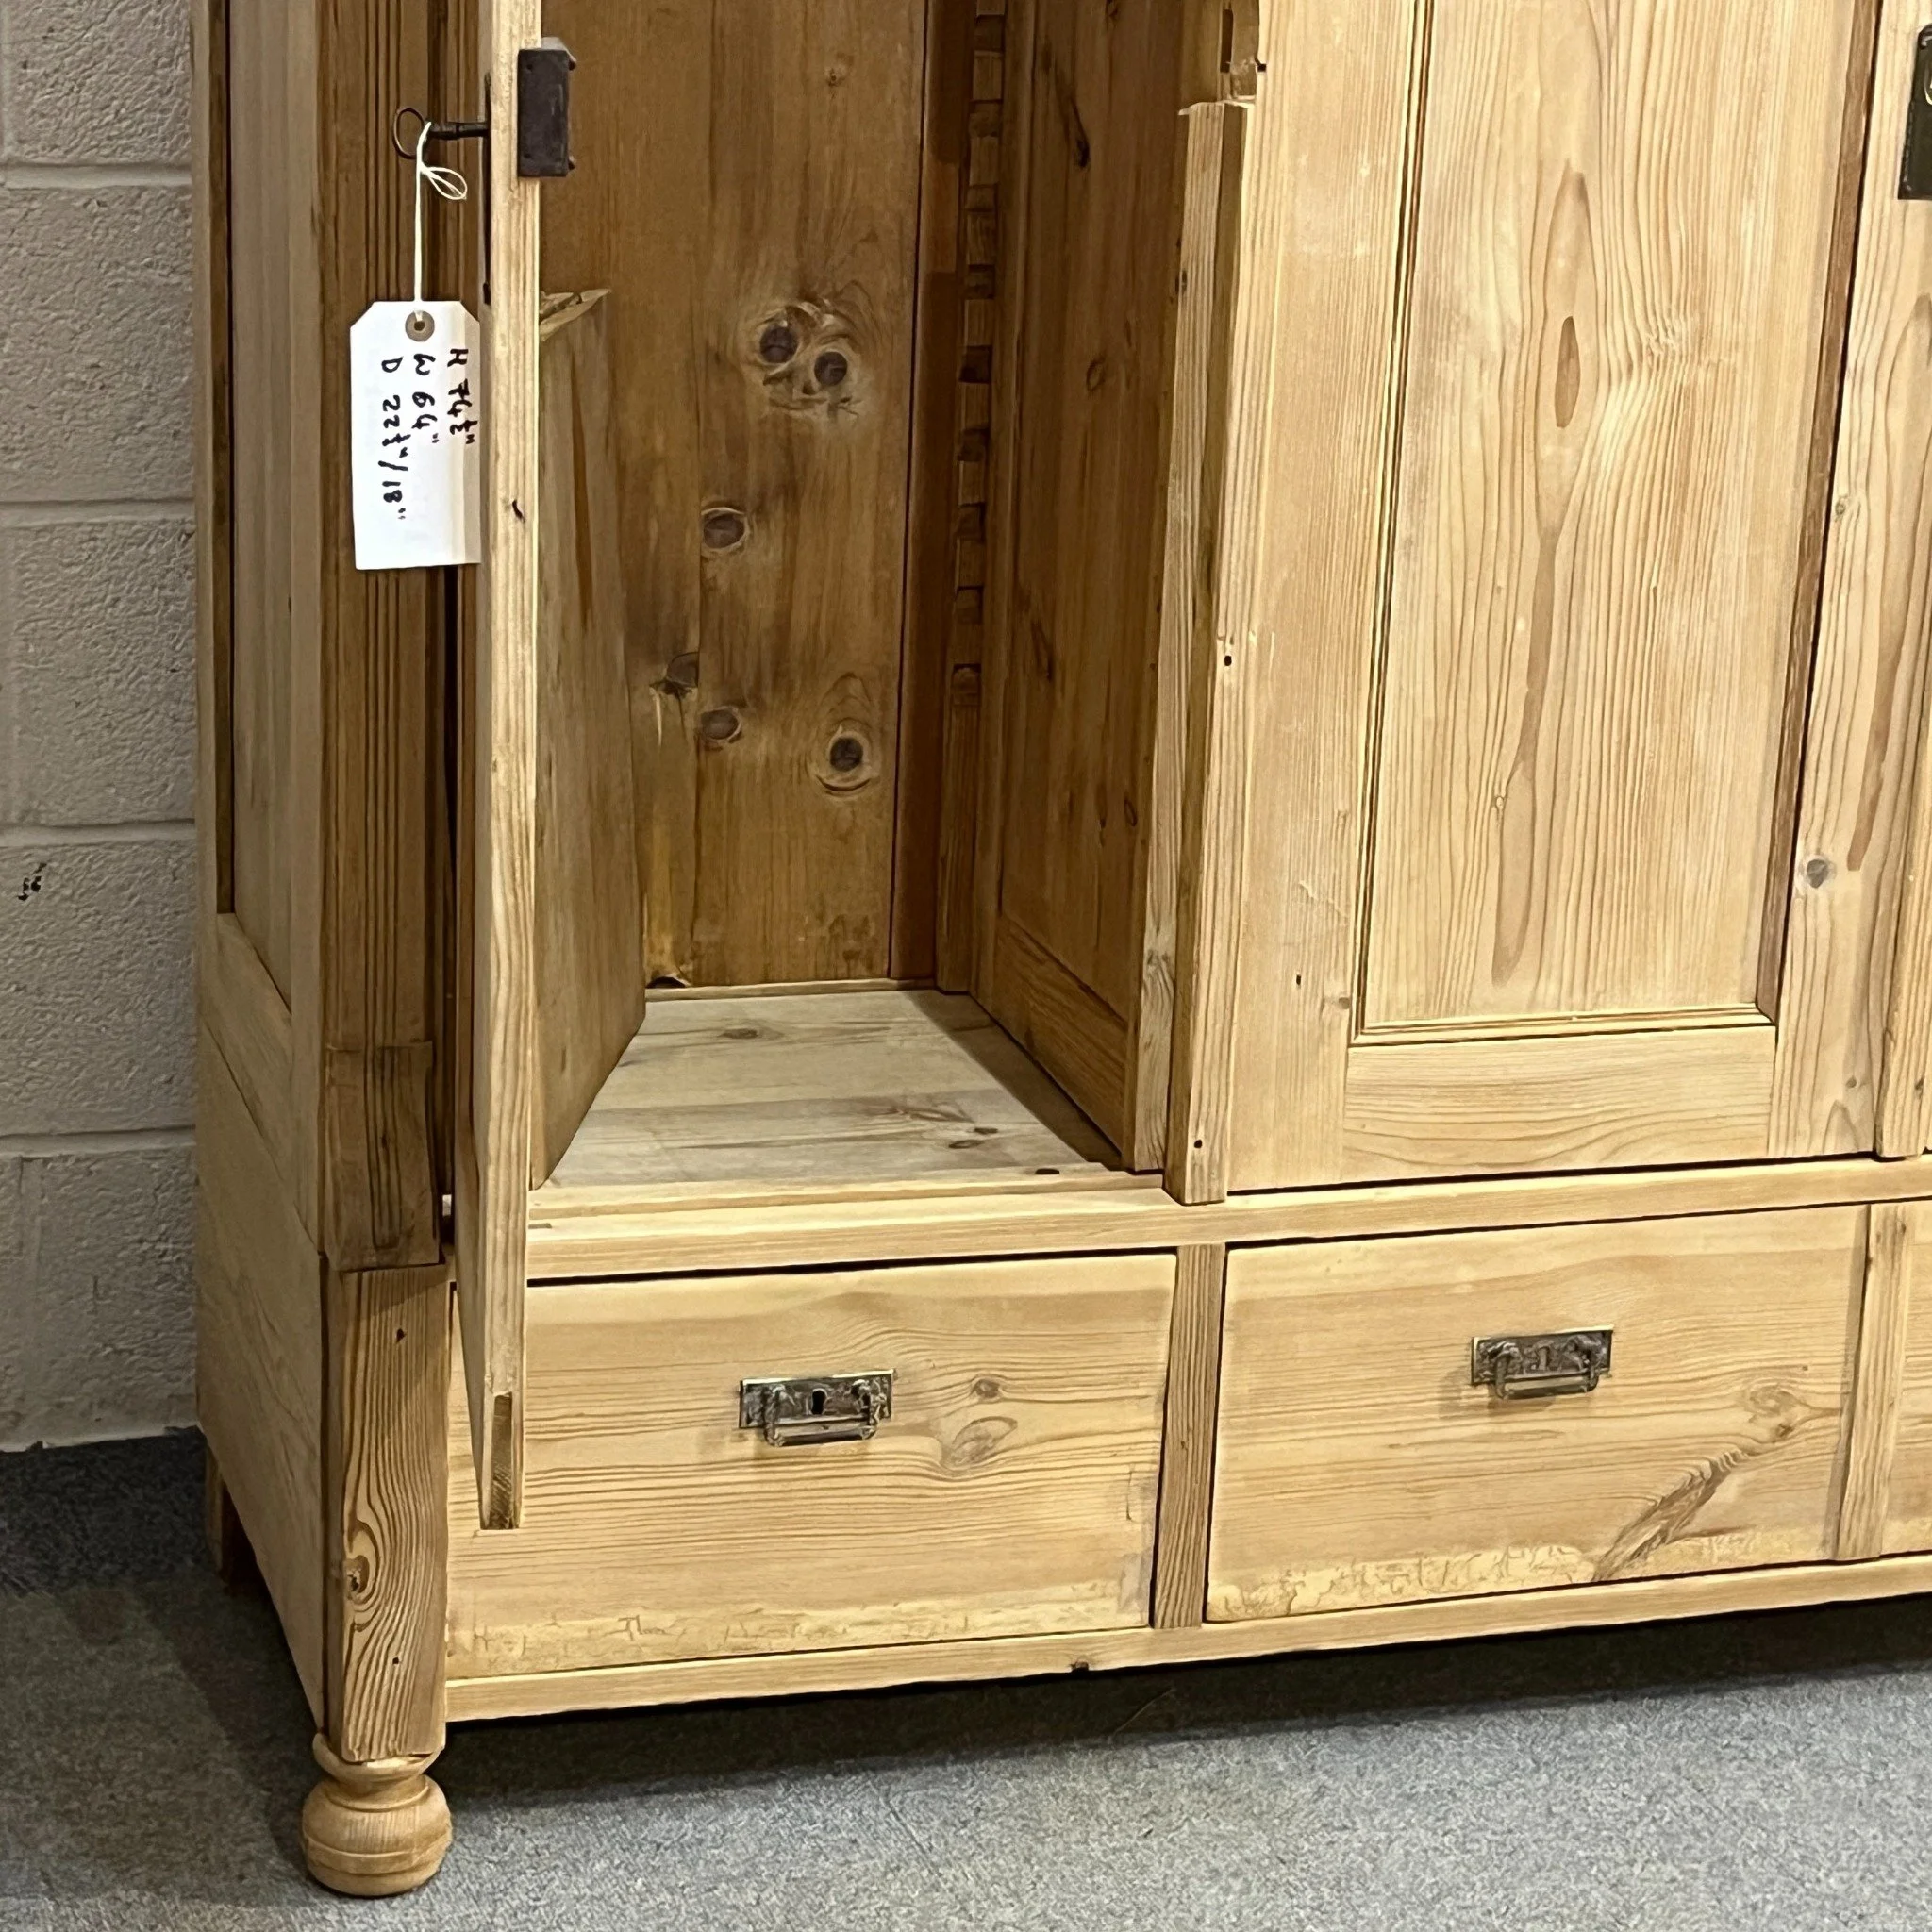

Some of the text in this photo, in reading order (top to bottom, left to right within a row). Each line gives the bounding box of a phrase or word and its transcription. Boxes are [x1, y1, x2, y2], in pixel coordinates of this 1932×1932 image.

[381, 357, 403, 373] D
[413, 354, 435, 375] W
[447, 349, 468, 367] H
